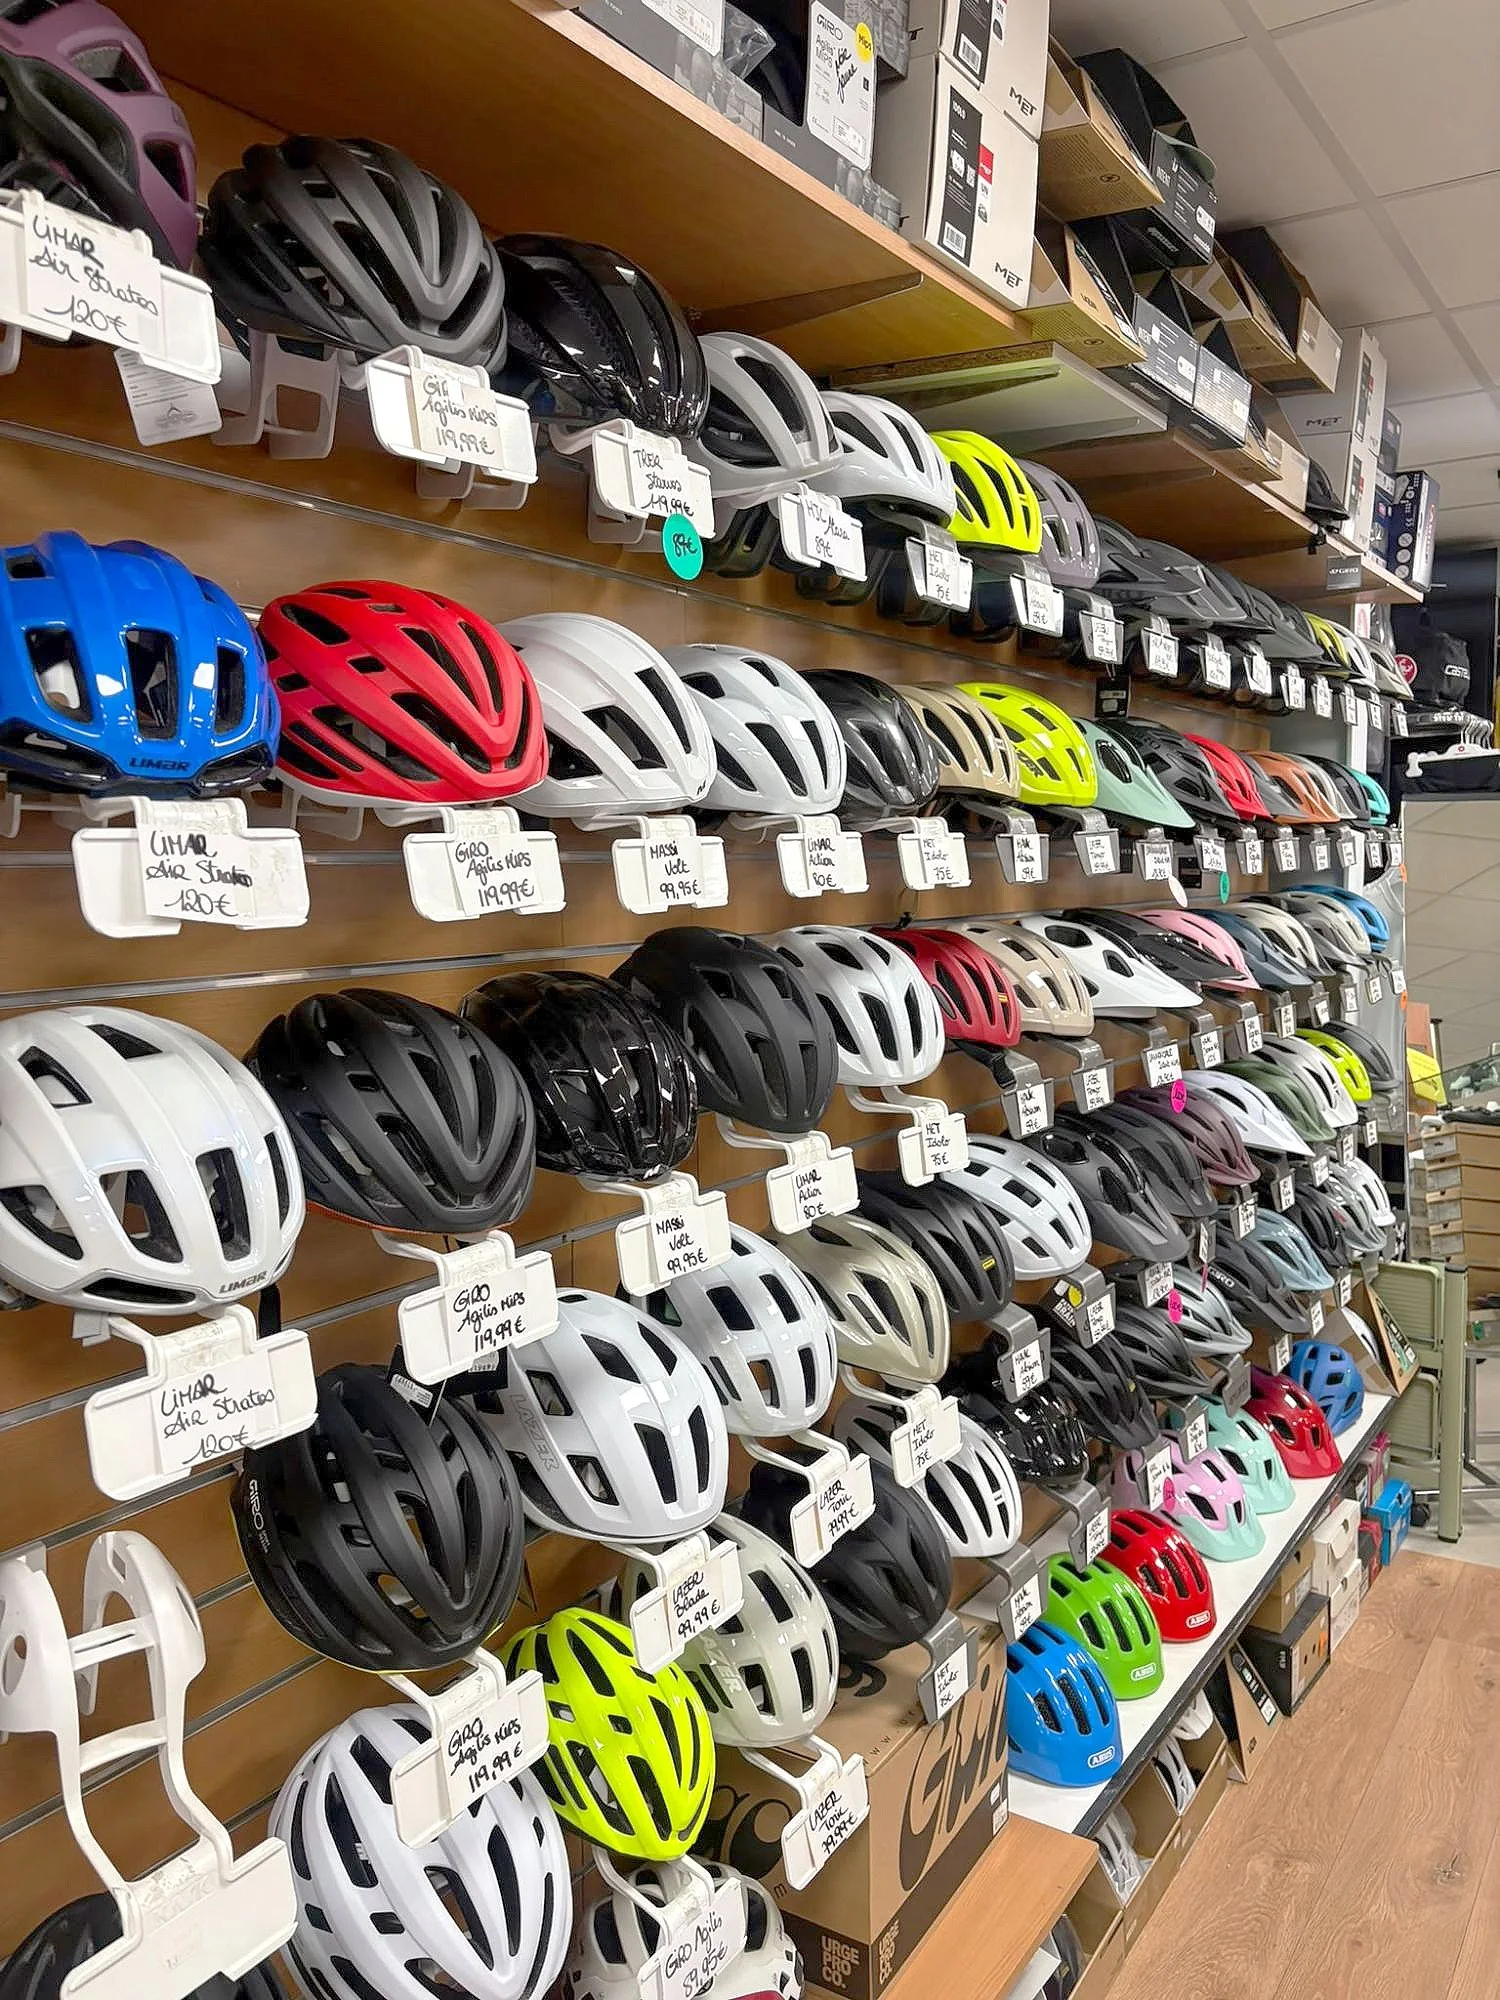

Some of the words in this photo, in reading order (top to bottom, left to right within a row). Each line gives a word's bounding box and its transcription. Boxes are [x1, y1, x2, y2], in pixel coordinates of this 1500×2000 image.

[816, 13, 844, 41] GIRO
[1009, 86, 1038, 117] MET
[995, 261, 1024, 288] MET
[44, 295, 142, 345] 120€
[422, 396, 467, 428] Agilis
[1306, 416, 1343, 429] MET
[923, 838, 936, 849] MET
[465, 852, 504, 885] Agilis
[664, 860, 691, 876] Volt
[808, 853, 836, 867] Action
[934, 866, 954, 880] 75€
[659, 882, 702, 900] 99,95€
[812, 871, 837, 888] 80€
[164, 888, 239, 918] 120€
[926, 1122, 941, 1136] MET
[930, 1151, 950, 1167] 75€
[799, 1186, 822, 1204] Action
[803, 1202, 827, 1220] 80€
[668, 1232, 694, 1252] Volt
[666, 1247, 708, 1275] 99,95€
[456, 1302, 498, 1334] Agilis
[474, 1315, 526, 1353] 119,99€
[181, 1424, 258, 1465] 120€
[914, 1447, 933, 1468] 75€
[249, 1479, 264, 1530] GIRO
[819, 1479, 847, 1510] LAZER
[672, 1570, 705, 1605] LAZER
[677, 1599, 721, 1638] 99,99€
[447, 1716, 484, 1757] GIRO
[468, 1741, 523, 1793] 119,99€
[807, 1789, 843, 1832] LAZER
[821, 1812, 859, 1854] 79,99€
[694, 1911, 723, 1954] Agilis
[821, 1934, 861, 1967] URGE
[822, 1950, 853, 1977] PRO
[821, 1965, 848, 1989] CO.
